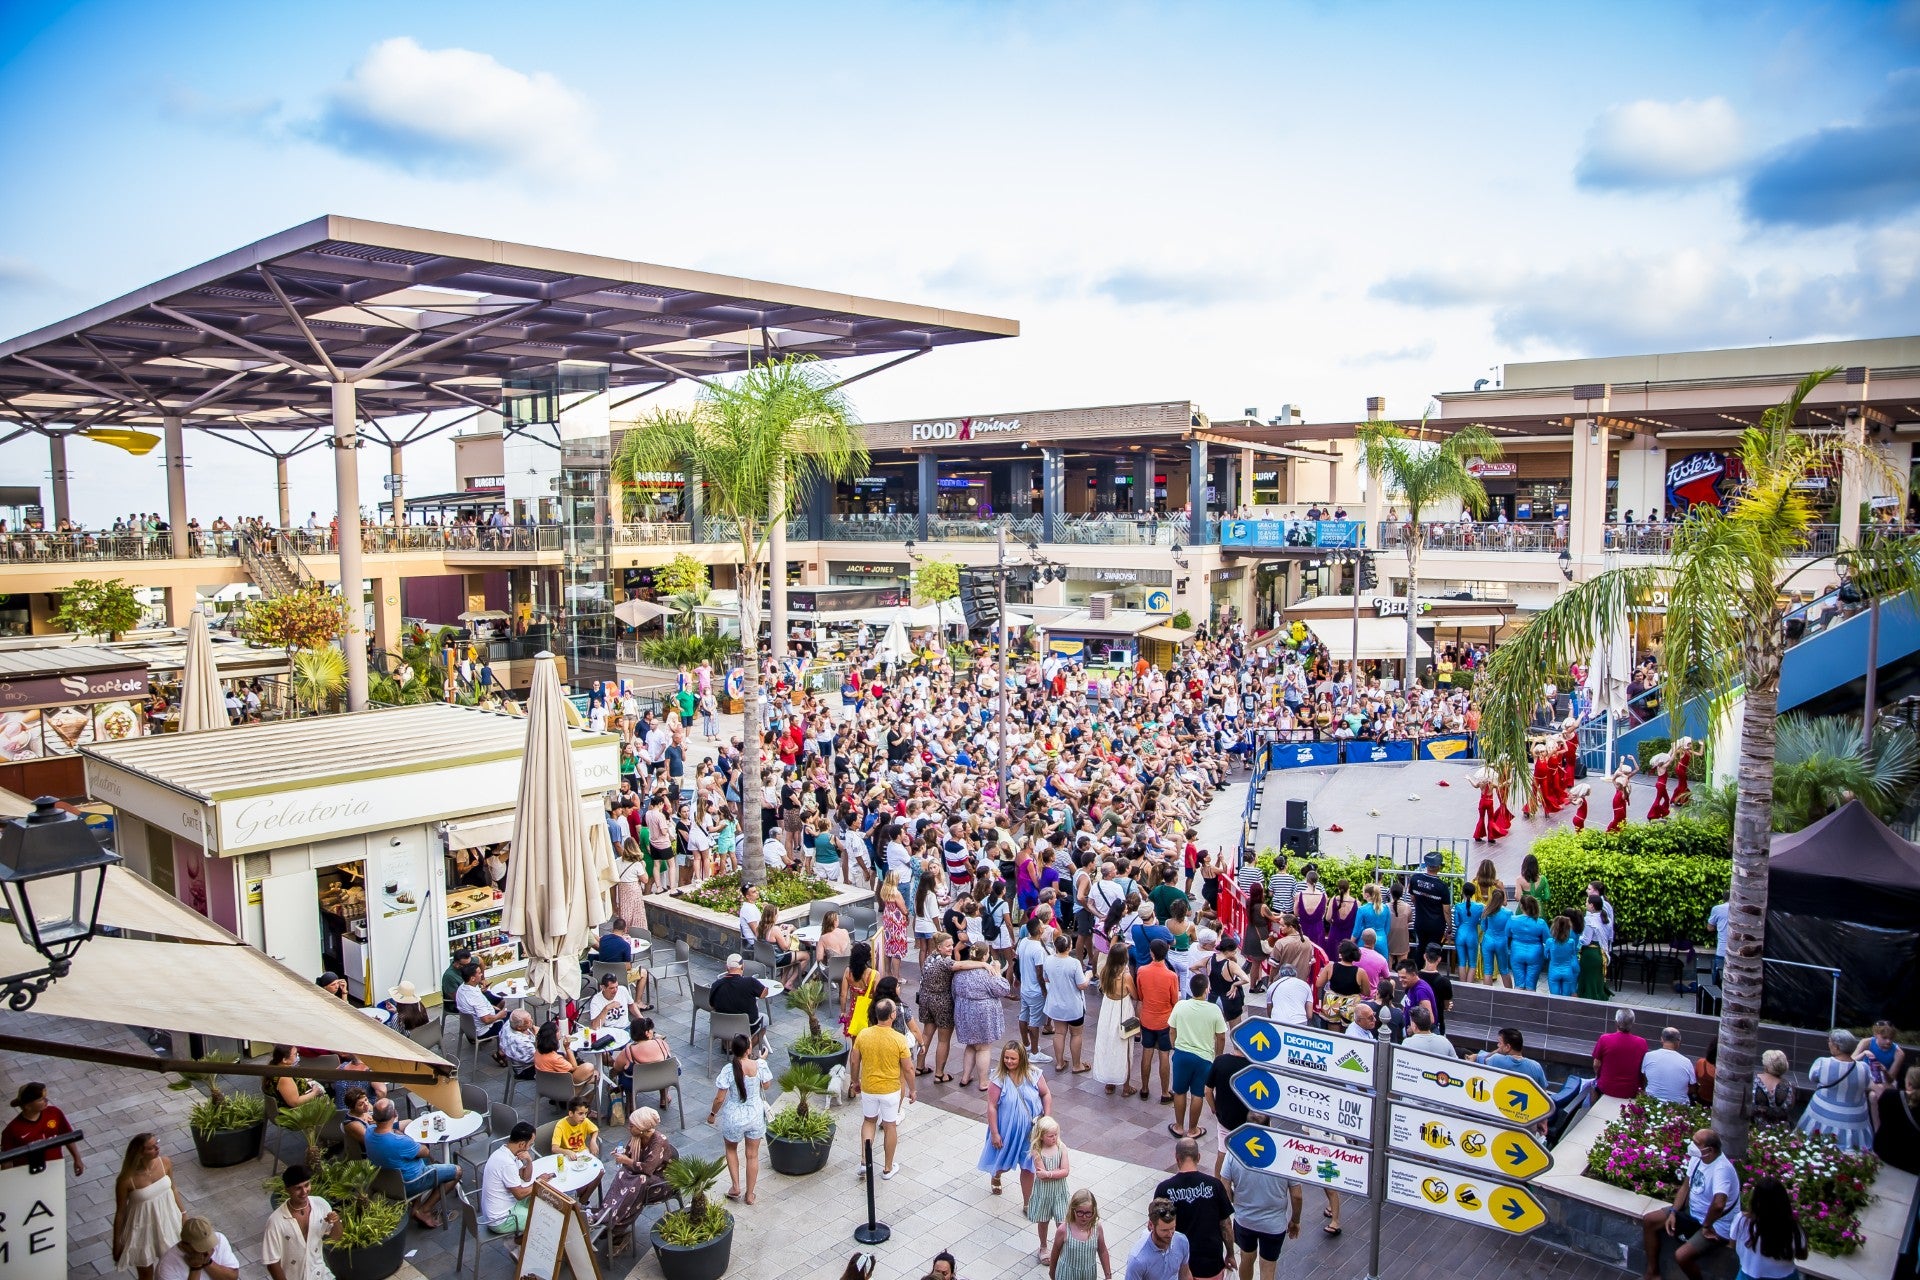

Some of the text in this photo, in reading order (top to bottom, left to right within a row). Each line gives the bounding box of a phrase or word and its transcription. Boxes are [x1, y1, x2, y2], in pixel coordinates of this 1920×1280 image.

[912, 422, 957, 440] FOOD
[474, 477, 495, 488] BURGER
[636, 471, 672, 482] BURGER
[846, 565, 864, 573] JACK
[1104, 572, 1137, 581] SWAROVSKI
[235, 798, 373, 844] Gelateria
[1286, 1034, 1331, 1052] DECATHLON
[1287, 1049, 1327, 1064] MAX
[1287, 1056, 1328, 1072] COLCHON
[1287, 1085, 1331, 1103] GEOX
[1288, 1102, 1331, 1121] GUESS
[1338, 1098, 1362, 1116] LOW
[1337, 1111, 1364, 1130] COST
[1283, 1138, 1364, 1165] Media Markt
[1166, 1182, 1214, 1204] Angels
